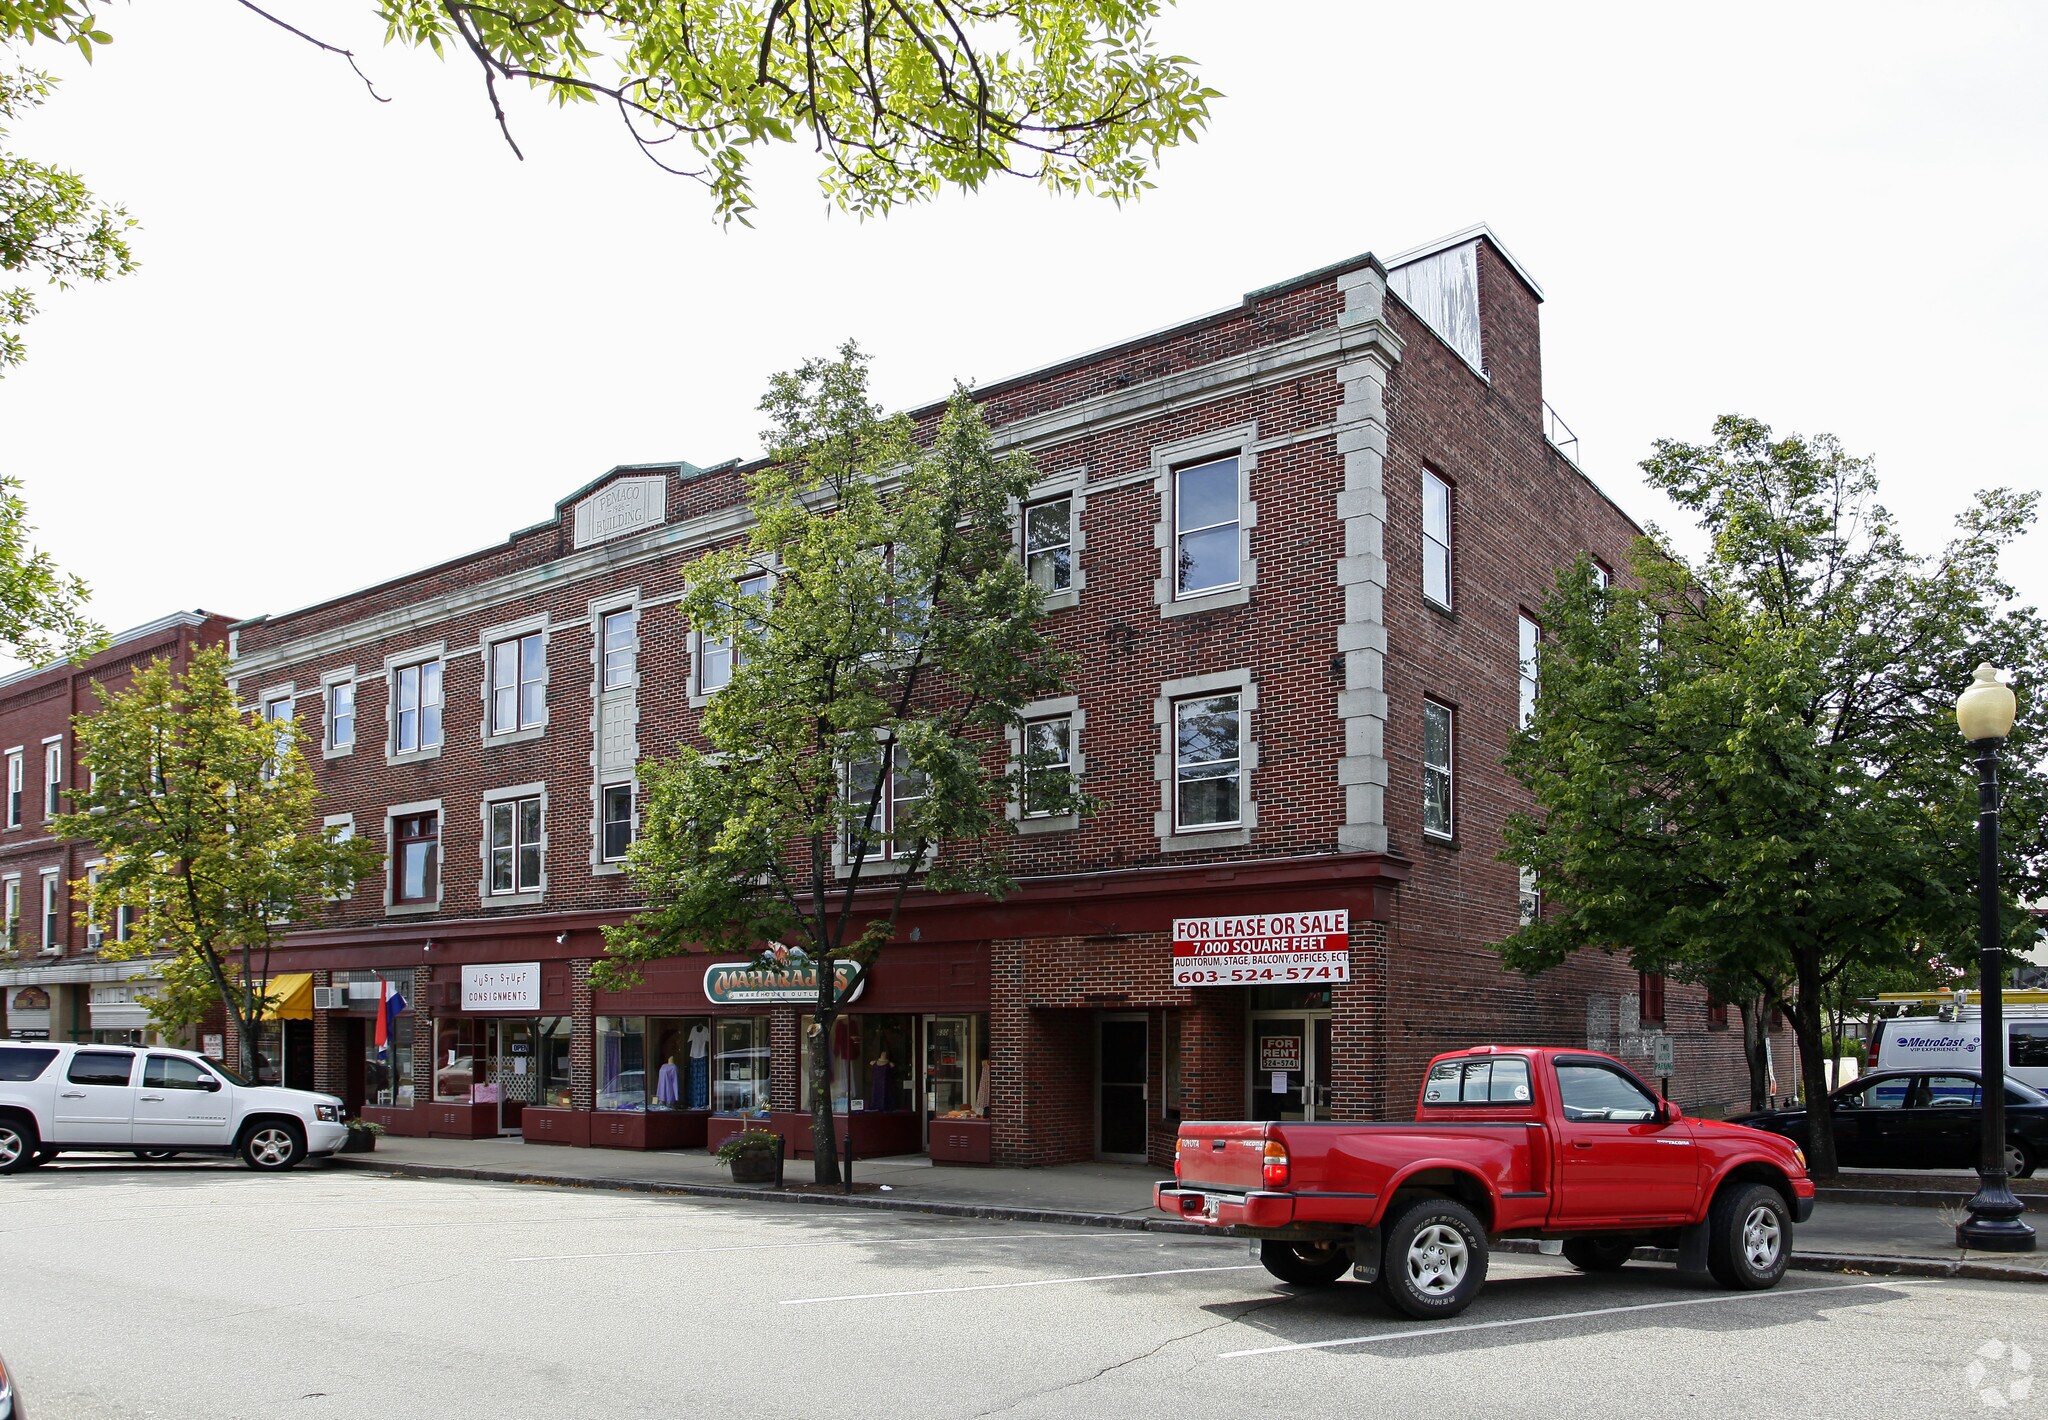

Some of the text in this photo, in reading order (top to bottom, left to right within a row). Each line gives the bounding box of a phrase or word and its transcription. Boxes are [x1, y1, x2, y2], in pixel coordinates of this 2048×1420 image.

[600, 486, 640, 511] PEMACO
[596, 508, 642, 534] BUILDING
[1177, 913, 1345, 939] FOR LEASE OR SALE
[1193, 936, 1327, 956] 7,000 SQUARE FEET
[1175, 957, 1222, 967] AUDITORUM,
[1224, 956, 1251, 966] STAGE,
[1252, 954, 1291, 965] BALCONY,
[1293, 952, 1329, 963] OFFICES,
[473, 972, 527, 986] JUST STUFF
[468, 991, 527, 1001] CONSIGNMENTS
[739, 990, 819, 998] WAREHOUSE OUTLE
[1267, 1039, 1293, 1048] FOR
[1907, 1037, 1965, 1047] MetroCast
[1263, 1048, 1298, 1057] RENT
[1182, 1139, 1200, 1148] TOYOTA
[1439, 1215, 1471, 1234] BRUTE
[1355, 1264, 1376, 1275] 4WD
